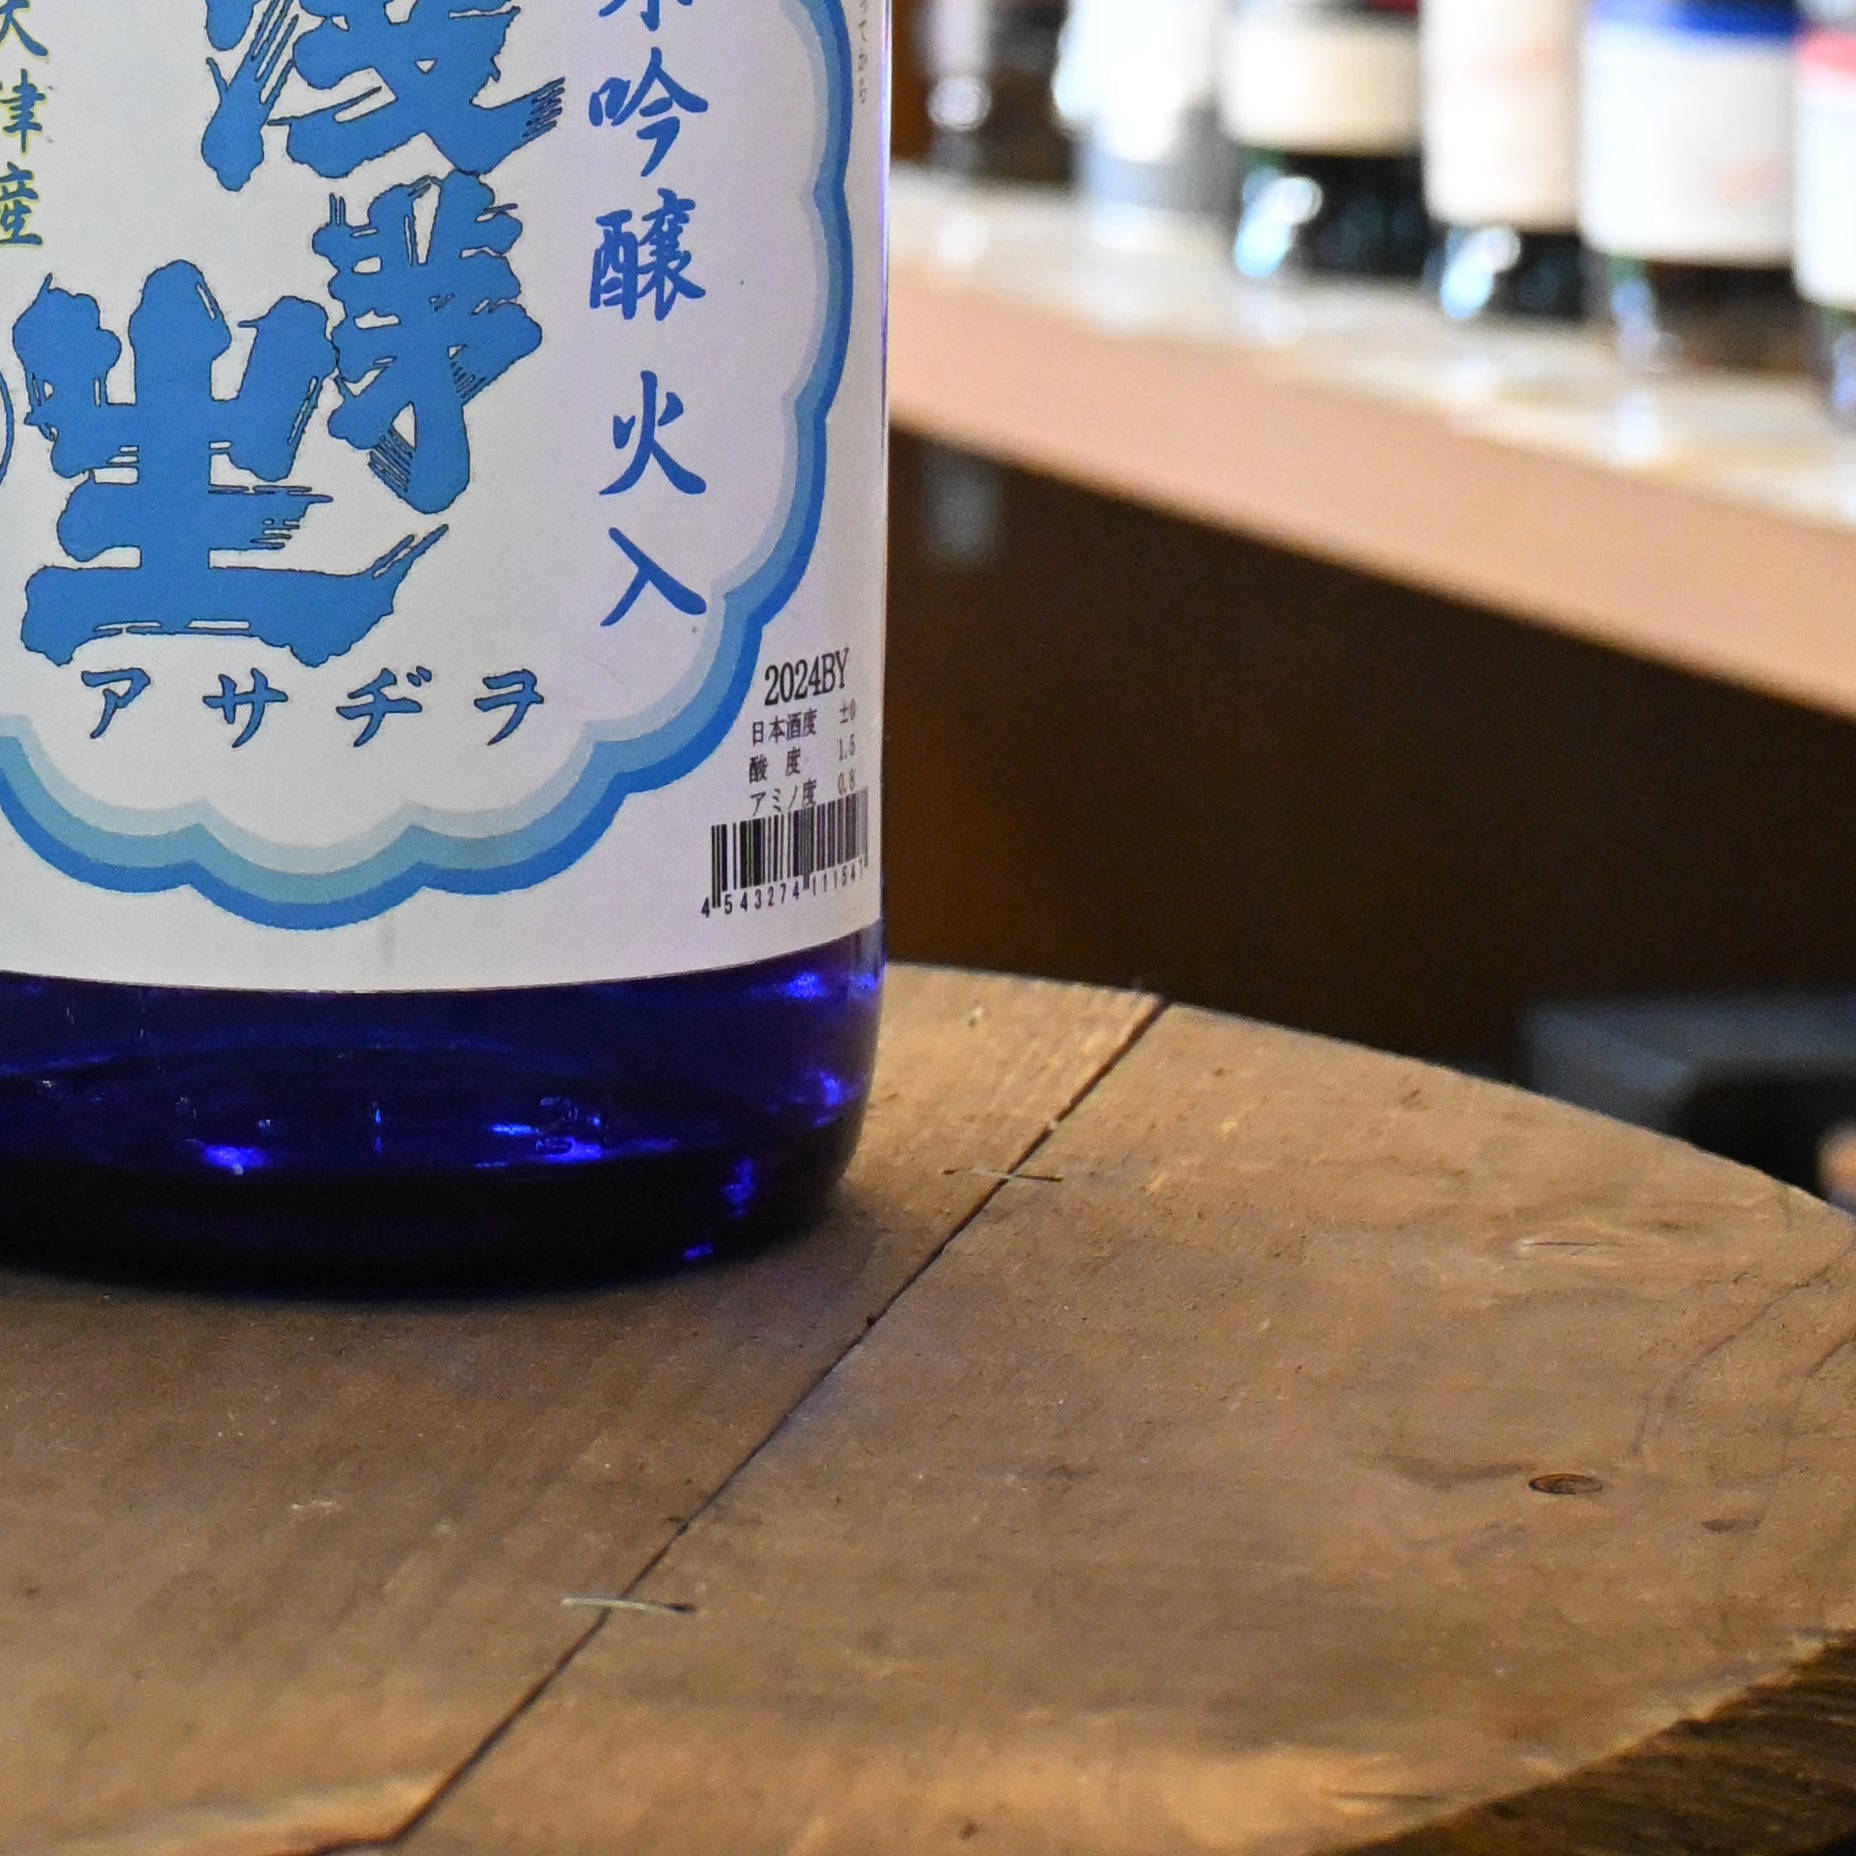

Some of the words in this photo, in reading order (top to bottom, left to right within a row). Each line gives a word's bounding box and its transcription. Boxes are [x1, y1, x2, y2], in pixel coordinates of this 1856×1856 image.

[764, 647, 850, 706] 2024BY
[752, 708, 818, 746] 日本酒度
[750, 779, 818, 816] アミノ度
